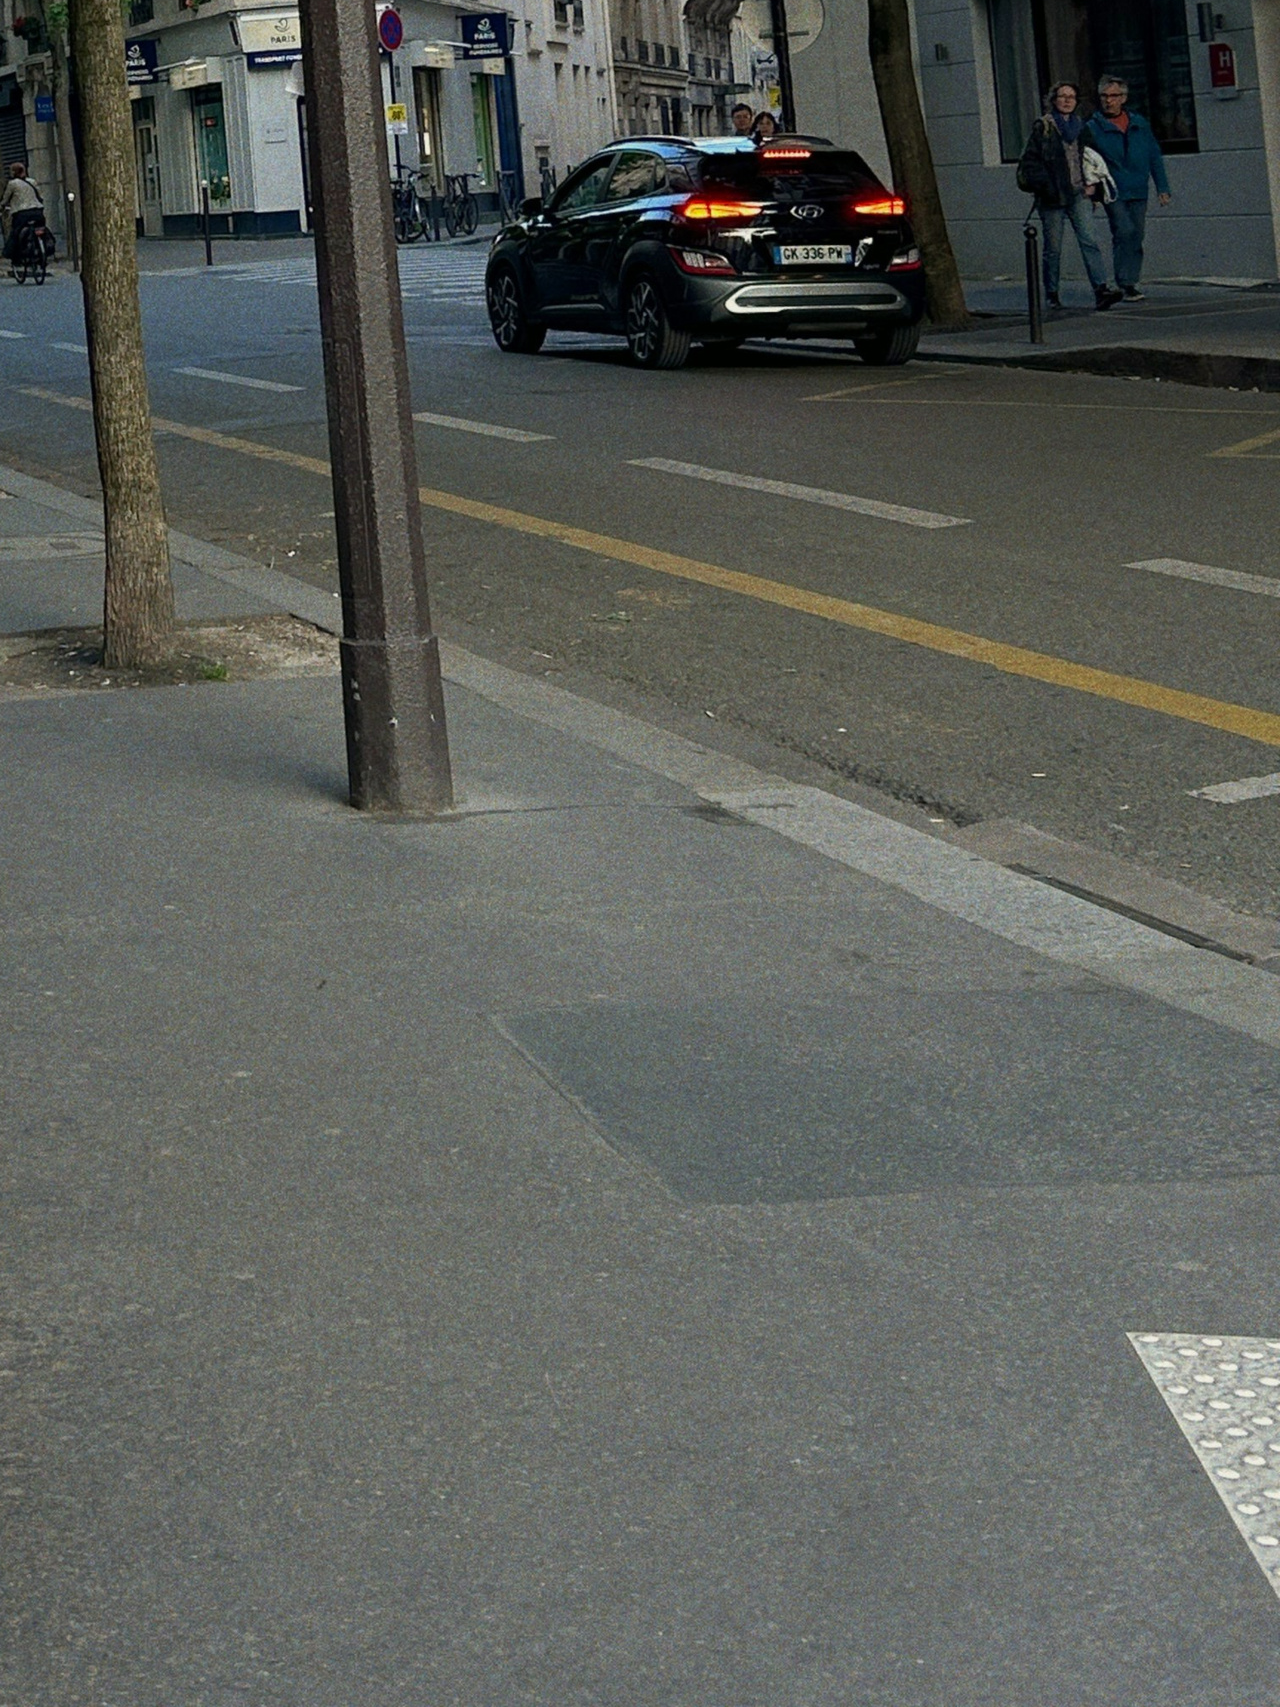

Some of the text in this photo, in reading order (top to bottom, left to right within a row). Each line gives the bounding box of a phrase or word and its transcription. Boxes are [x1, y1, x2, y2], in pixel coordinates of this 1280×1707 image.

[270, 35, 297, 44] PARIS
[1219, 50, 1231, 68] H
[783, 248, 799, 260] GK
[803, 247, 825, 260] 336
